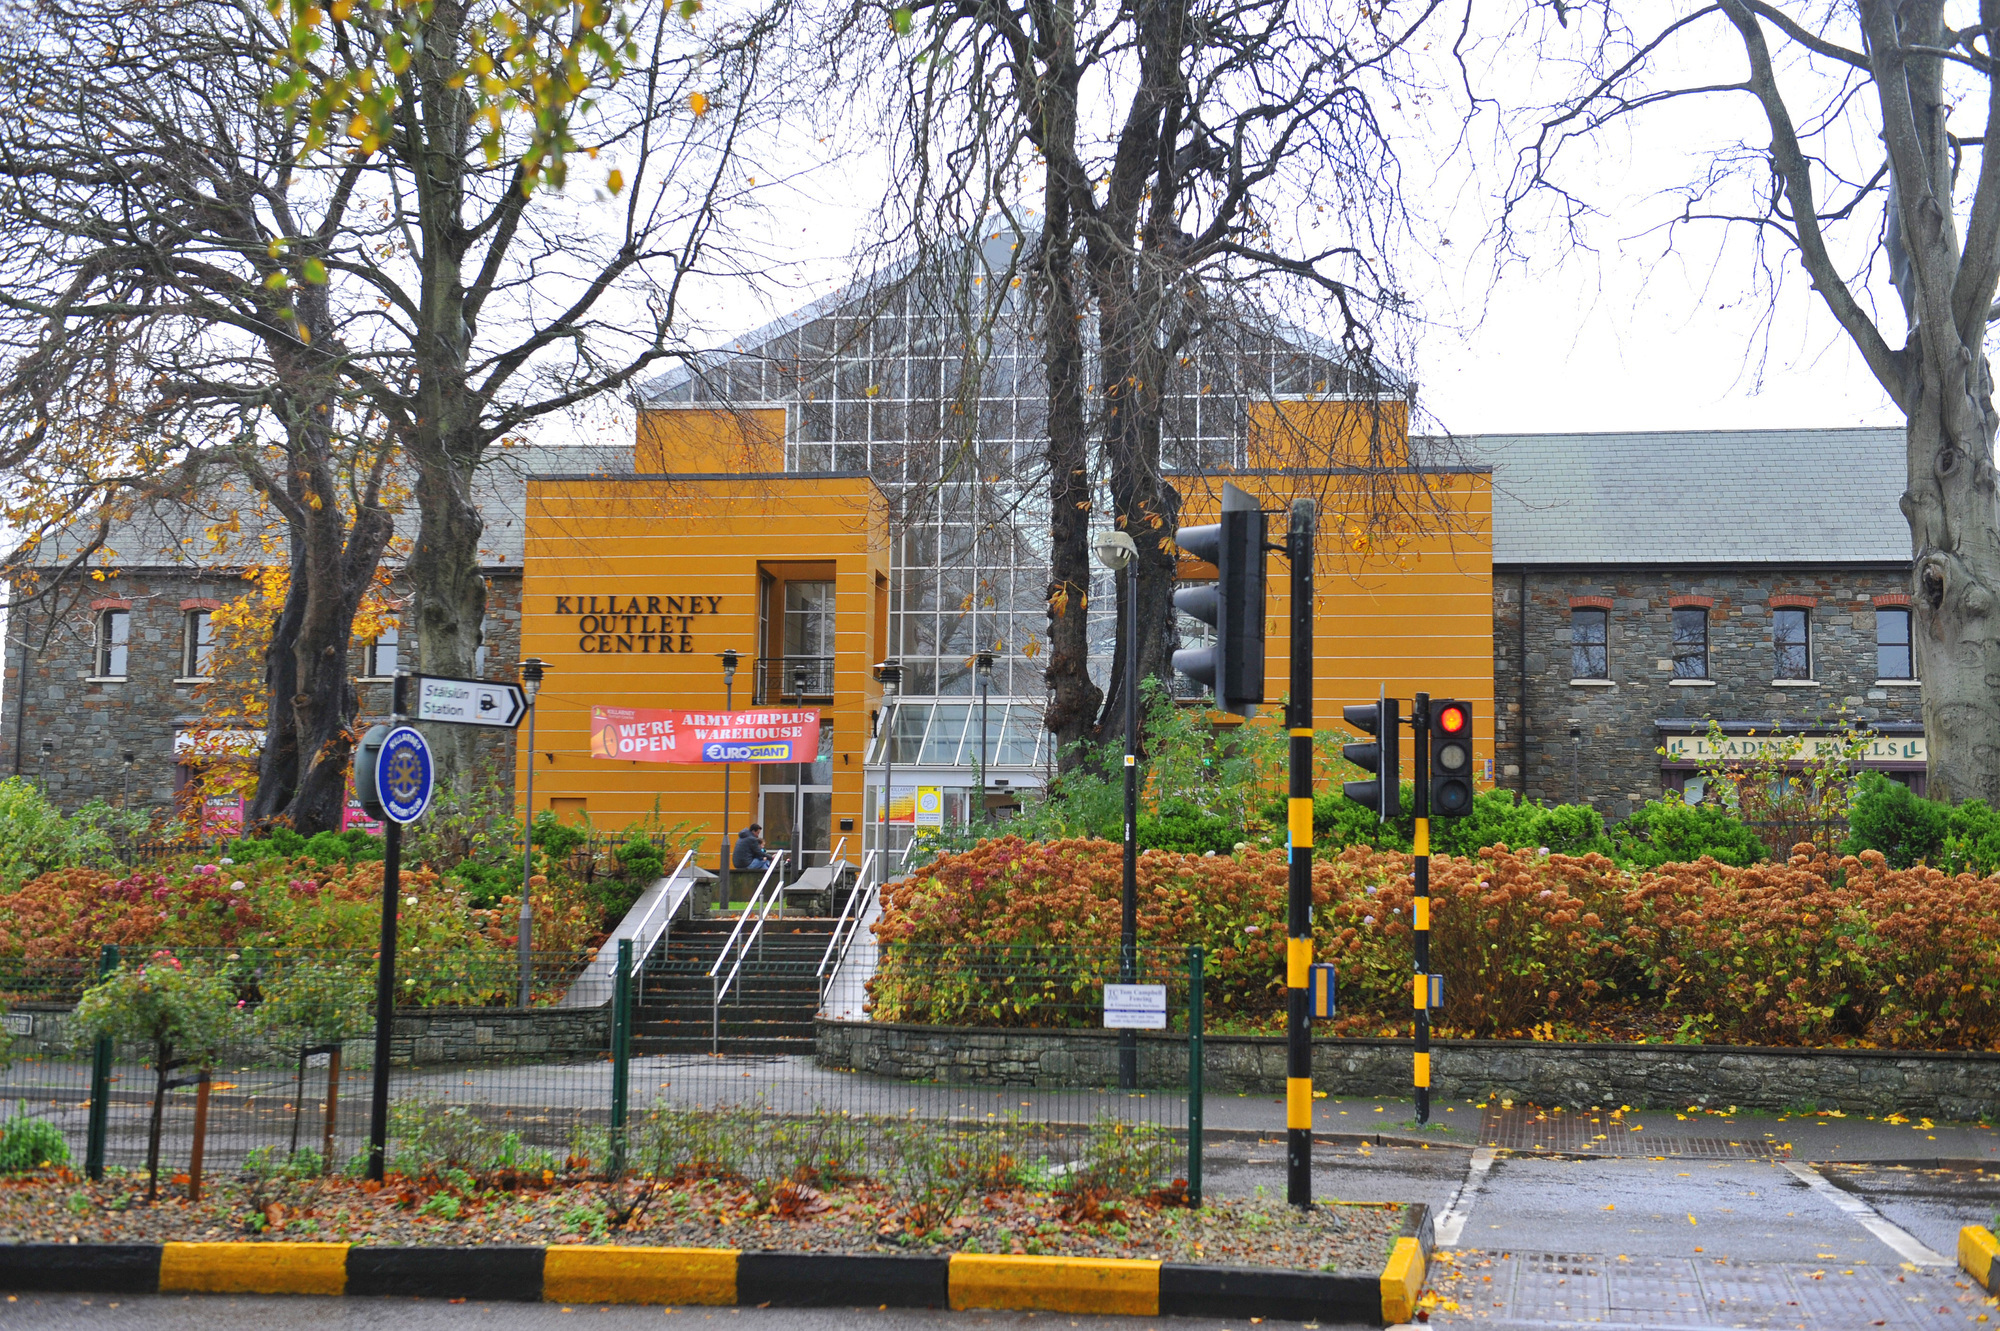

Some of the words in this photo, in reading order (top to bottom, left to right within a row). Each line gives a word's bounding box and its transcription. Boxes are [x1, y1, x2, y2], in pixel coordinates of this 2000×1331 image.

[554, 595, 723, 615] KILLARNEY
[579, 614, 695, 634] OUTLET
[578, 634, 694, 653] CENTRE
[425, 684, 470, 700] Stáisiún
[423, 701, 465, 716] Station
[681, 713, 733, 727] ARMY
[735, 712, 815, 726] SURPLUS
[694, 726, 803, 741] WAREHOUSE
[619, 734, 676, 753] OPEN
